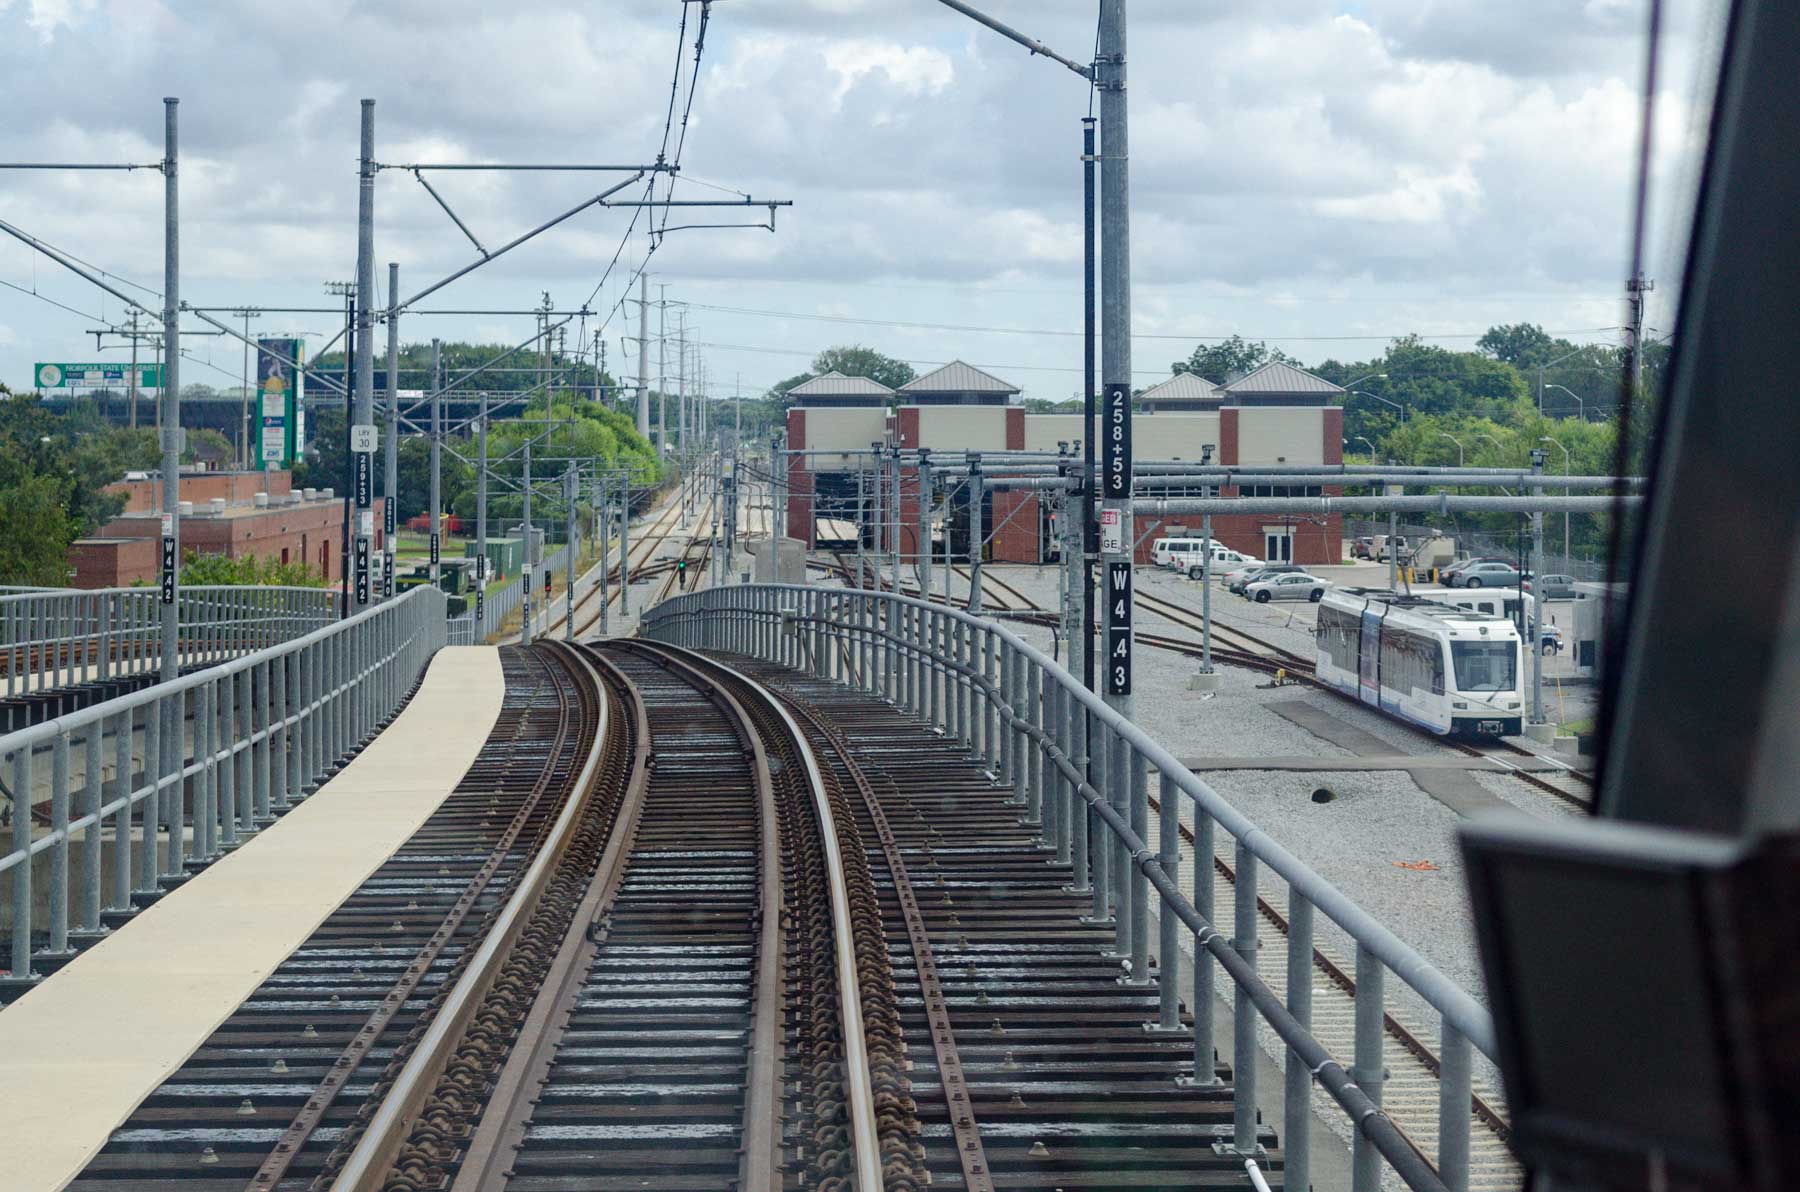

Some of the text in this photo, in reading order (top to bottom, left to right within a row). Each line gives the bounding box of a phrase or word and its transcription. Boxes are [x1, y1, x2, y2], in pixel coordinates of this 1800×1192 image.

[65, 364, 98, 372] NORFOLK
[100, 364, 119, 372] STATE
[1112, 390, 1123, 490] 258+53
[359, 455, 367, 505] 259+33
